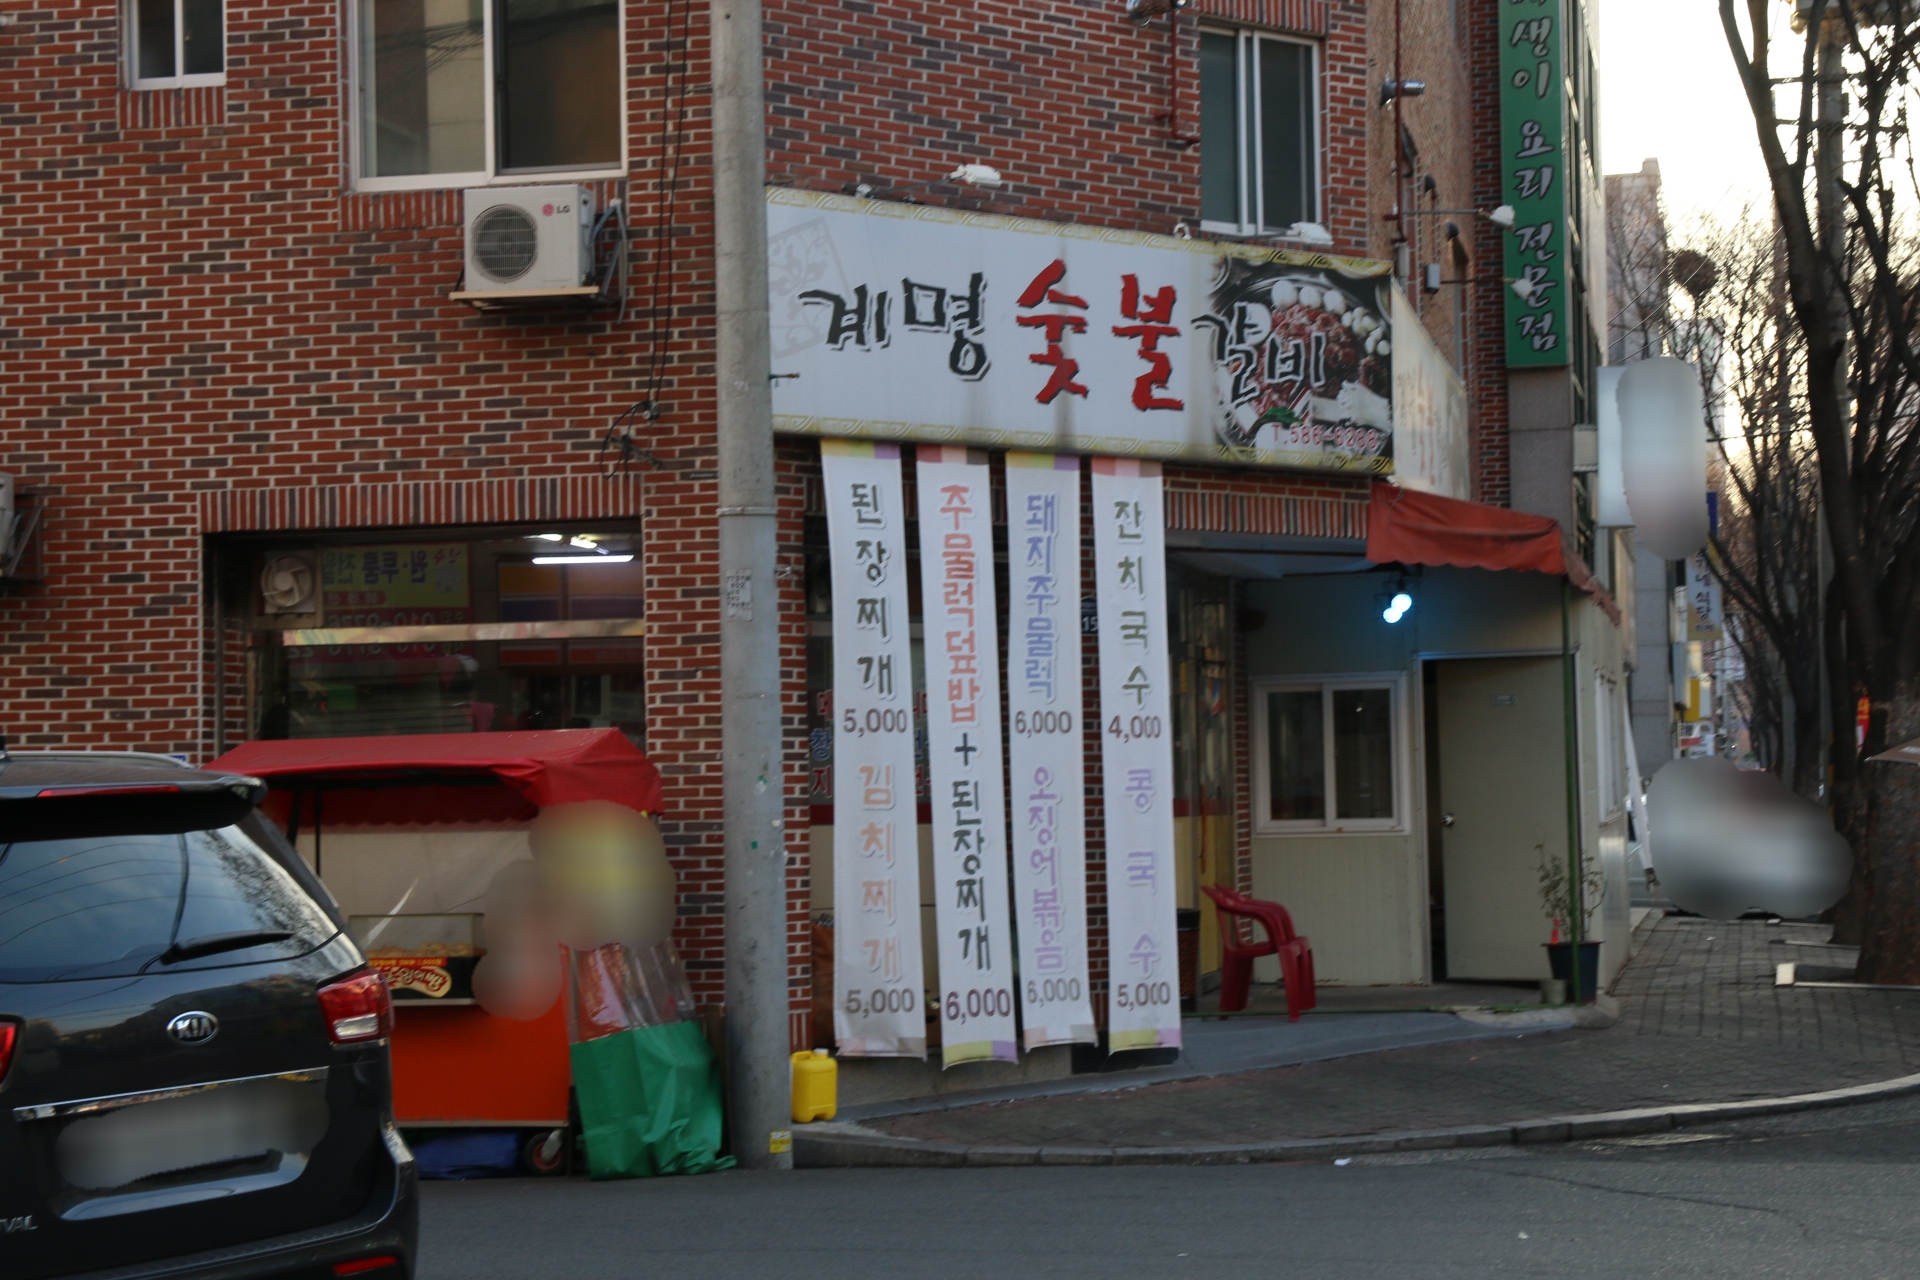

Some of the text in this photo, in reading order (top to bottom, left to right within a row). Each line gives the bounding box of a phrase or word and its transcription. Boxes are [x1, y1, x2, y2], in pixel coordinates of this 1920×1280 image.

[557, 205, 571, 214] LG
[1508, 0, 1557, 353] 생이 요리 전문점
[798, 271, 992, 382] 계명
[851, 482, 894, 695] 된장찌개
[940, 484, 981, 724] 주물럭덮밥
[1025, 494, 1056, 699] 돼지주물럭
[1114, 501, 1151, 706] 잔치국수
[842, 707, 908, 737] 5,000
[1015, 710, 1073, 738] 6,000
[1108, 714, 1162, 744] 4,000
[859, 766, 899, 979] 김치찌개
[951, 780, 992, 972] 된장찌개
[1124, 768, 1159, 975] 콩국수
[175, 1016, 214, 1039] KIA
[845, 988, 916, 1019] 5,000
[945, 987, 1012, 1025] 6,000
[1026, 977, 1082, 1008] 6,000
[1116, 981, 1171, 1012] 5,000
